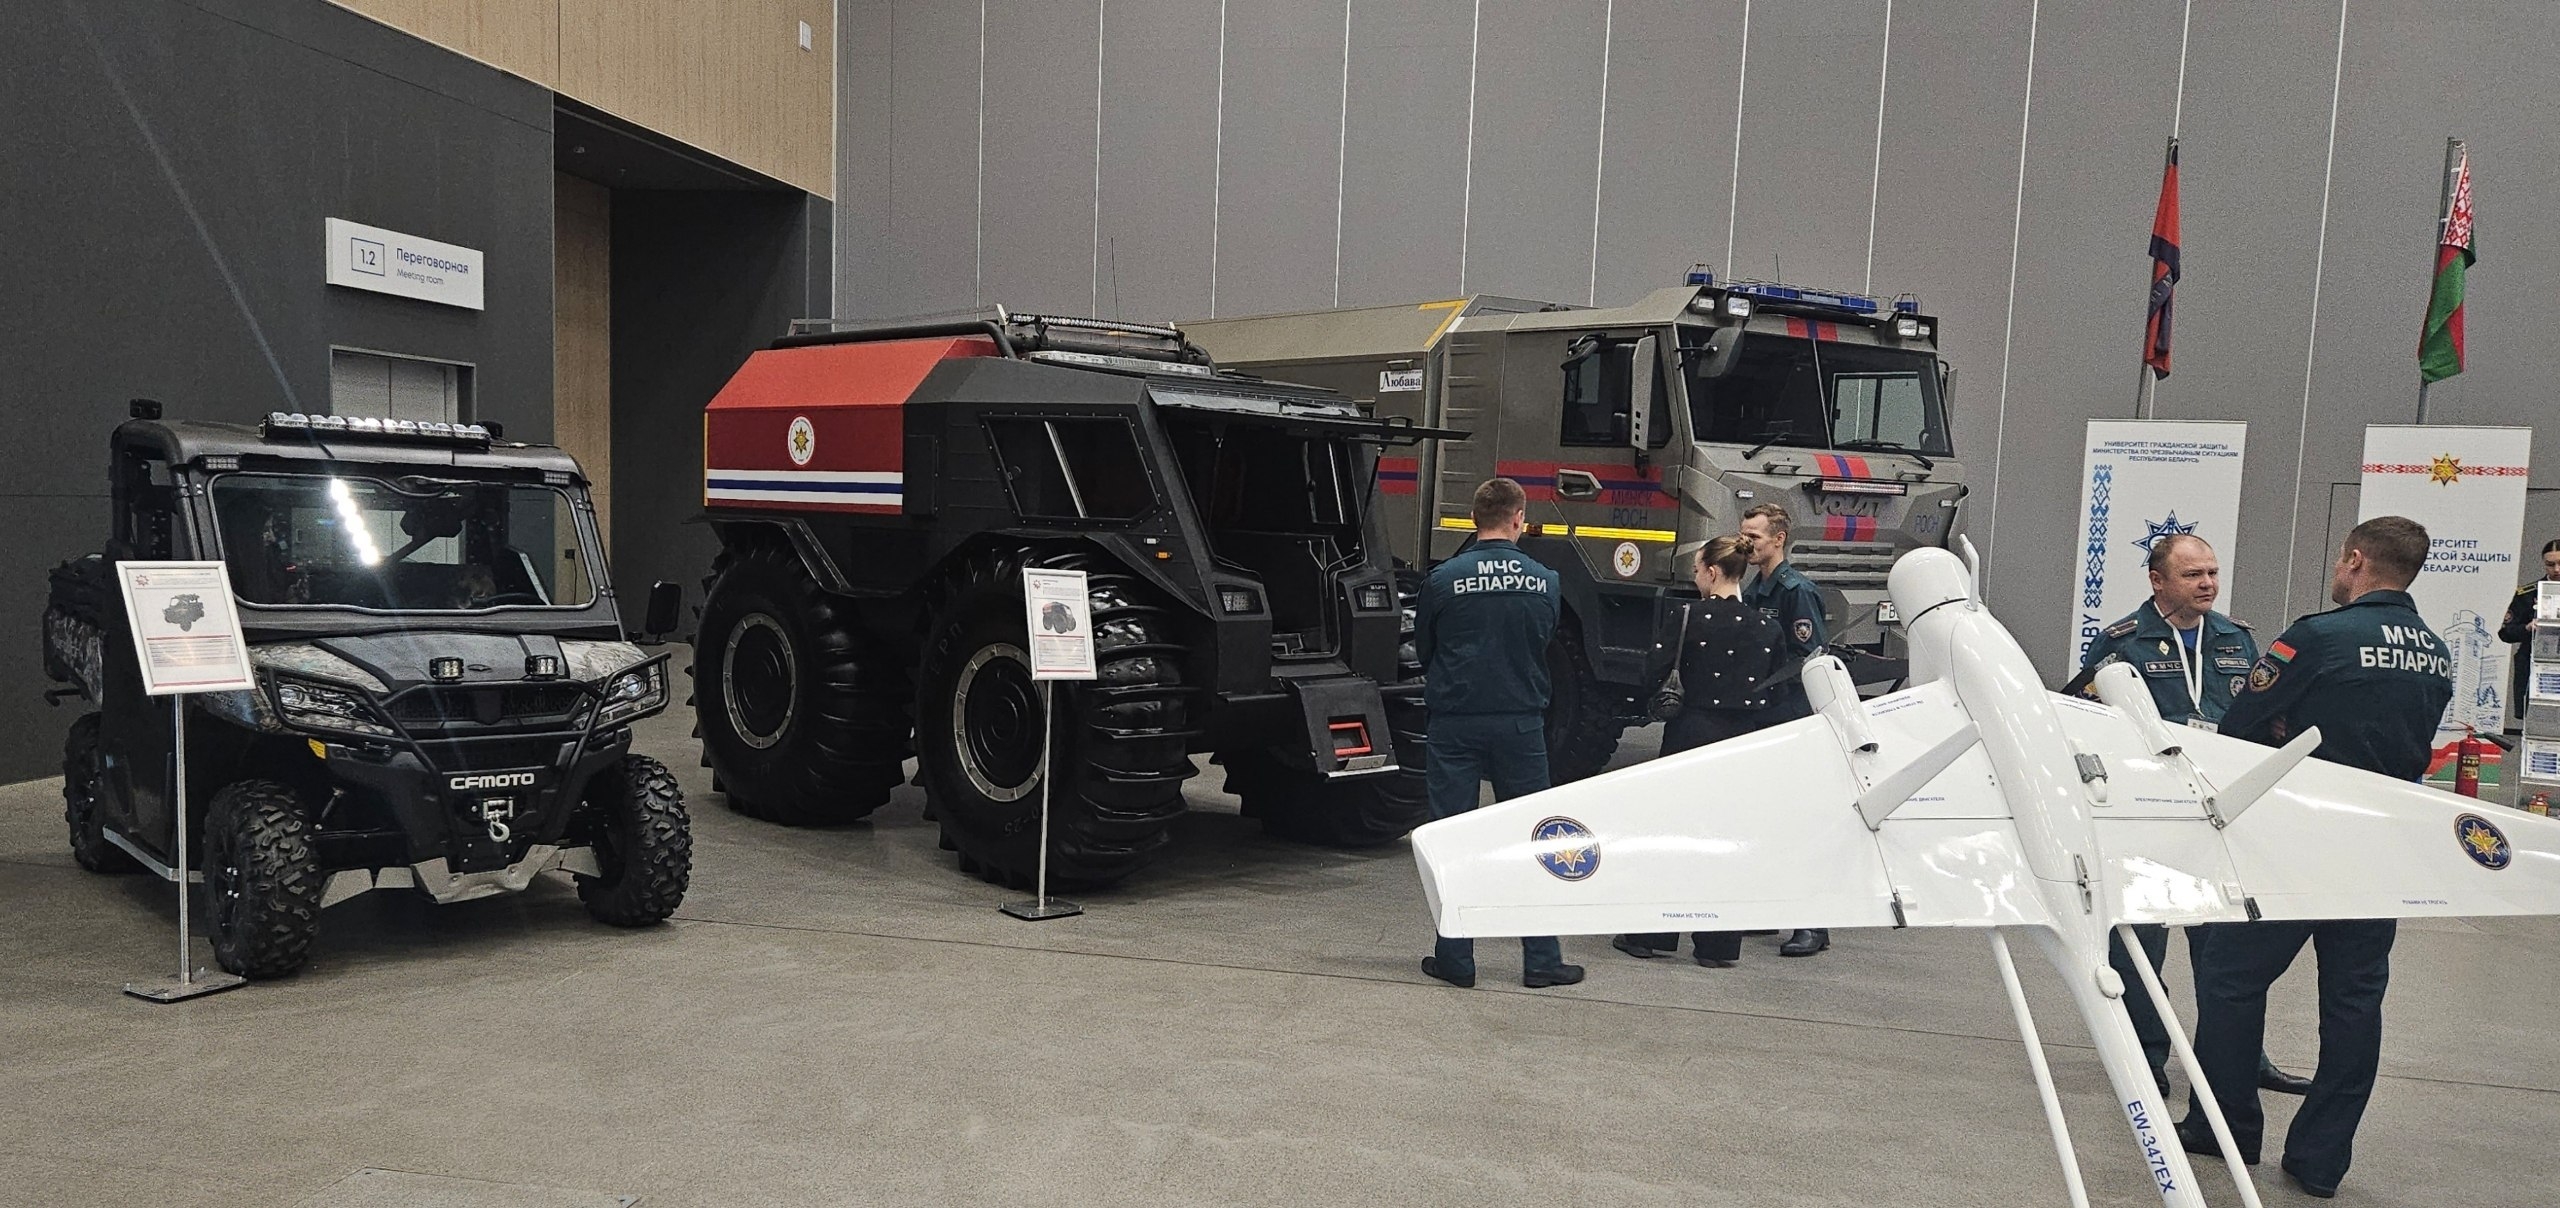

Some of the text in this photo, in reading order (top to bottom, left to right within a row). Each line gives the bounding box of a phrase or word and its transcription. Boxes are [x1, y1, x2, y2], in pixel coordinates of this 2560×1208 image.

[360, 248, 376, 266] 1.2
[396, 247, 469, 274] Переговорная
[396, 268, 445, 285] Meeting room
[1380, 372, 1421, 390] Любава
[2149, 442, 2198, 450] ГРАЖДАНСКОЙ
[2432, 539, 2479, 549] ЕРСИТЕТ
[2460, 552, 2512, 562] ЗАЩИТЫ
[1477, 559, 1523, 575] МЧС
[2423, 564, 2480, 573] БЕЛАРУСИ
[1453, 574, 1548, 594] БЕЛАРУСИ
[2381, 624, 2436, 650] МЧС
[450, 772, 535, 790] CFMOTO
[2127, 1100, 2177, 1195] EW-347EX
